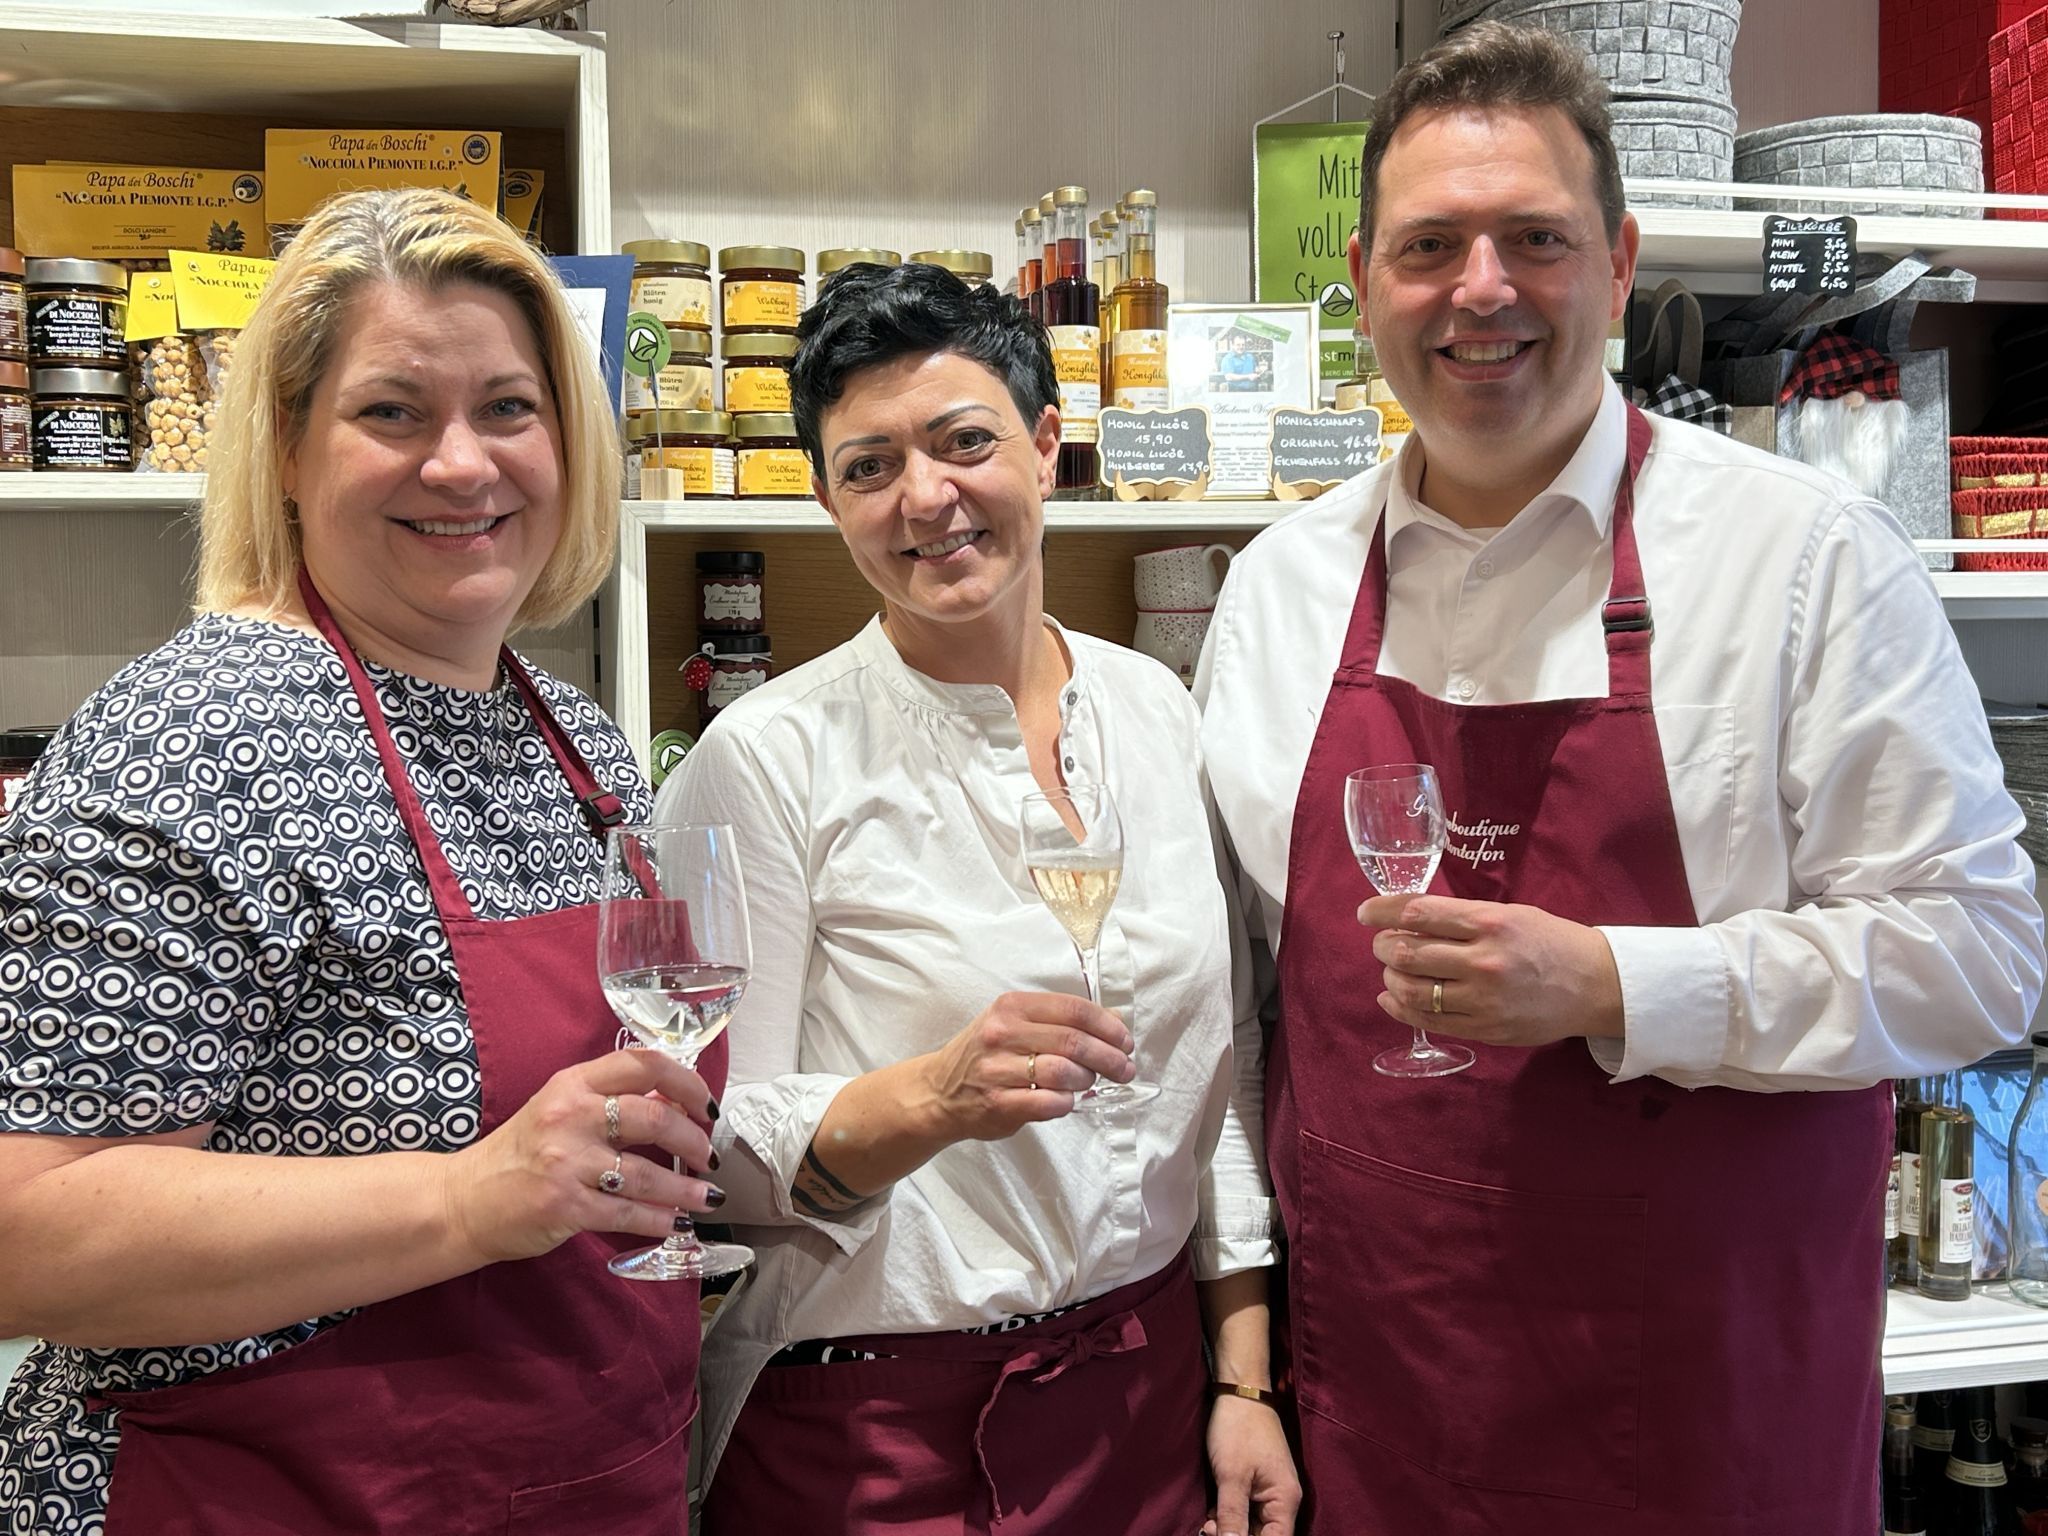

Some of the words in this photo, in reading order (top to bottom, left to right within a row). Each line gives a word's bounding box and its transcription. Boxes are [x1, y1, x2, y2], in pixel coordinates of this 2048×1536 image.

[329, 134, 364, 156] Papa
[366, 139, 378, 150] dei
[380, 132, 427, 151] Boschi
[368, 156, 427, 170] PIEMONTE
[86, 171, 125, 192] Papa
[127, 177, 141, 187] dei
[1319, 153, 1361, 200] Mit
[130, 192, 194, 206] PIEMONTE
[1774, 220, 1843, 232] FILZKÖRBE
[1771, 238, 1795, 248] MINI
[1824, 238, 1848, 251] 3,50
[1769, 250, 1800, 260] KLEIN
[1824, 250, 1849, 262] 4,50
[218, 259, 256, 277] Papa
[1769, 263, 1807, 275] MITTEL
[1822, 261, 1850, 275] 5,50
[1820, 276, 1849, 290] 6,50
[68, 300, 98, 311] CREMA
[49, 311, 58, 319] DI
[59, 309, 100, 320] NOCCIOLA
[68, 410, 98, 421] CREMA
[1275, 415, 1366, 427] HONIGSCHNAPS
[50, 421, 59, 429] DI
[60, 419, 101, 430] NOCCIOLA
[1106, 418, 1146, 430] HONIG
[1150, 418, 1190, 430] LIKÖR
[1135, 434, 1173, 447] 15,90
[1280, 437, 1339, 448] ORIGINAL
[1106, 449, 1145, 458] HONIG
[1149, 448, 1185, 459] LIKÖR
[1273, 455, 1341, 467] EICHENFASS
[1177, 460, 1210, 475] 17,90
